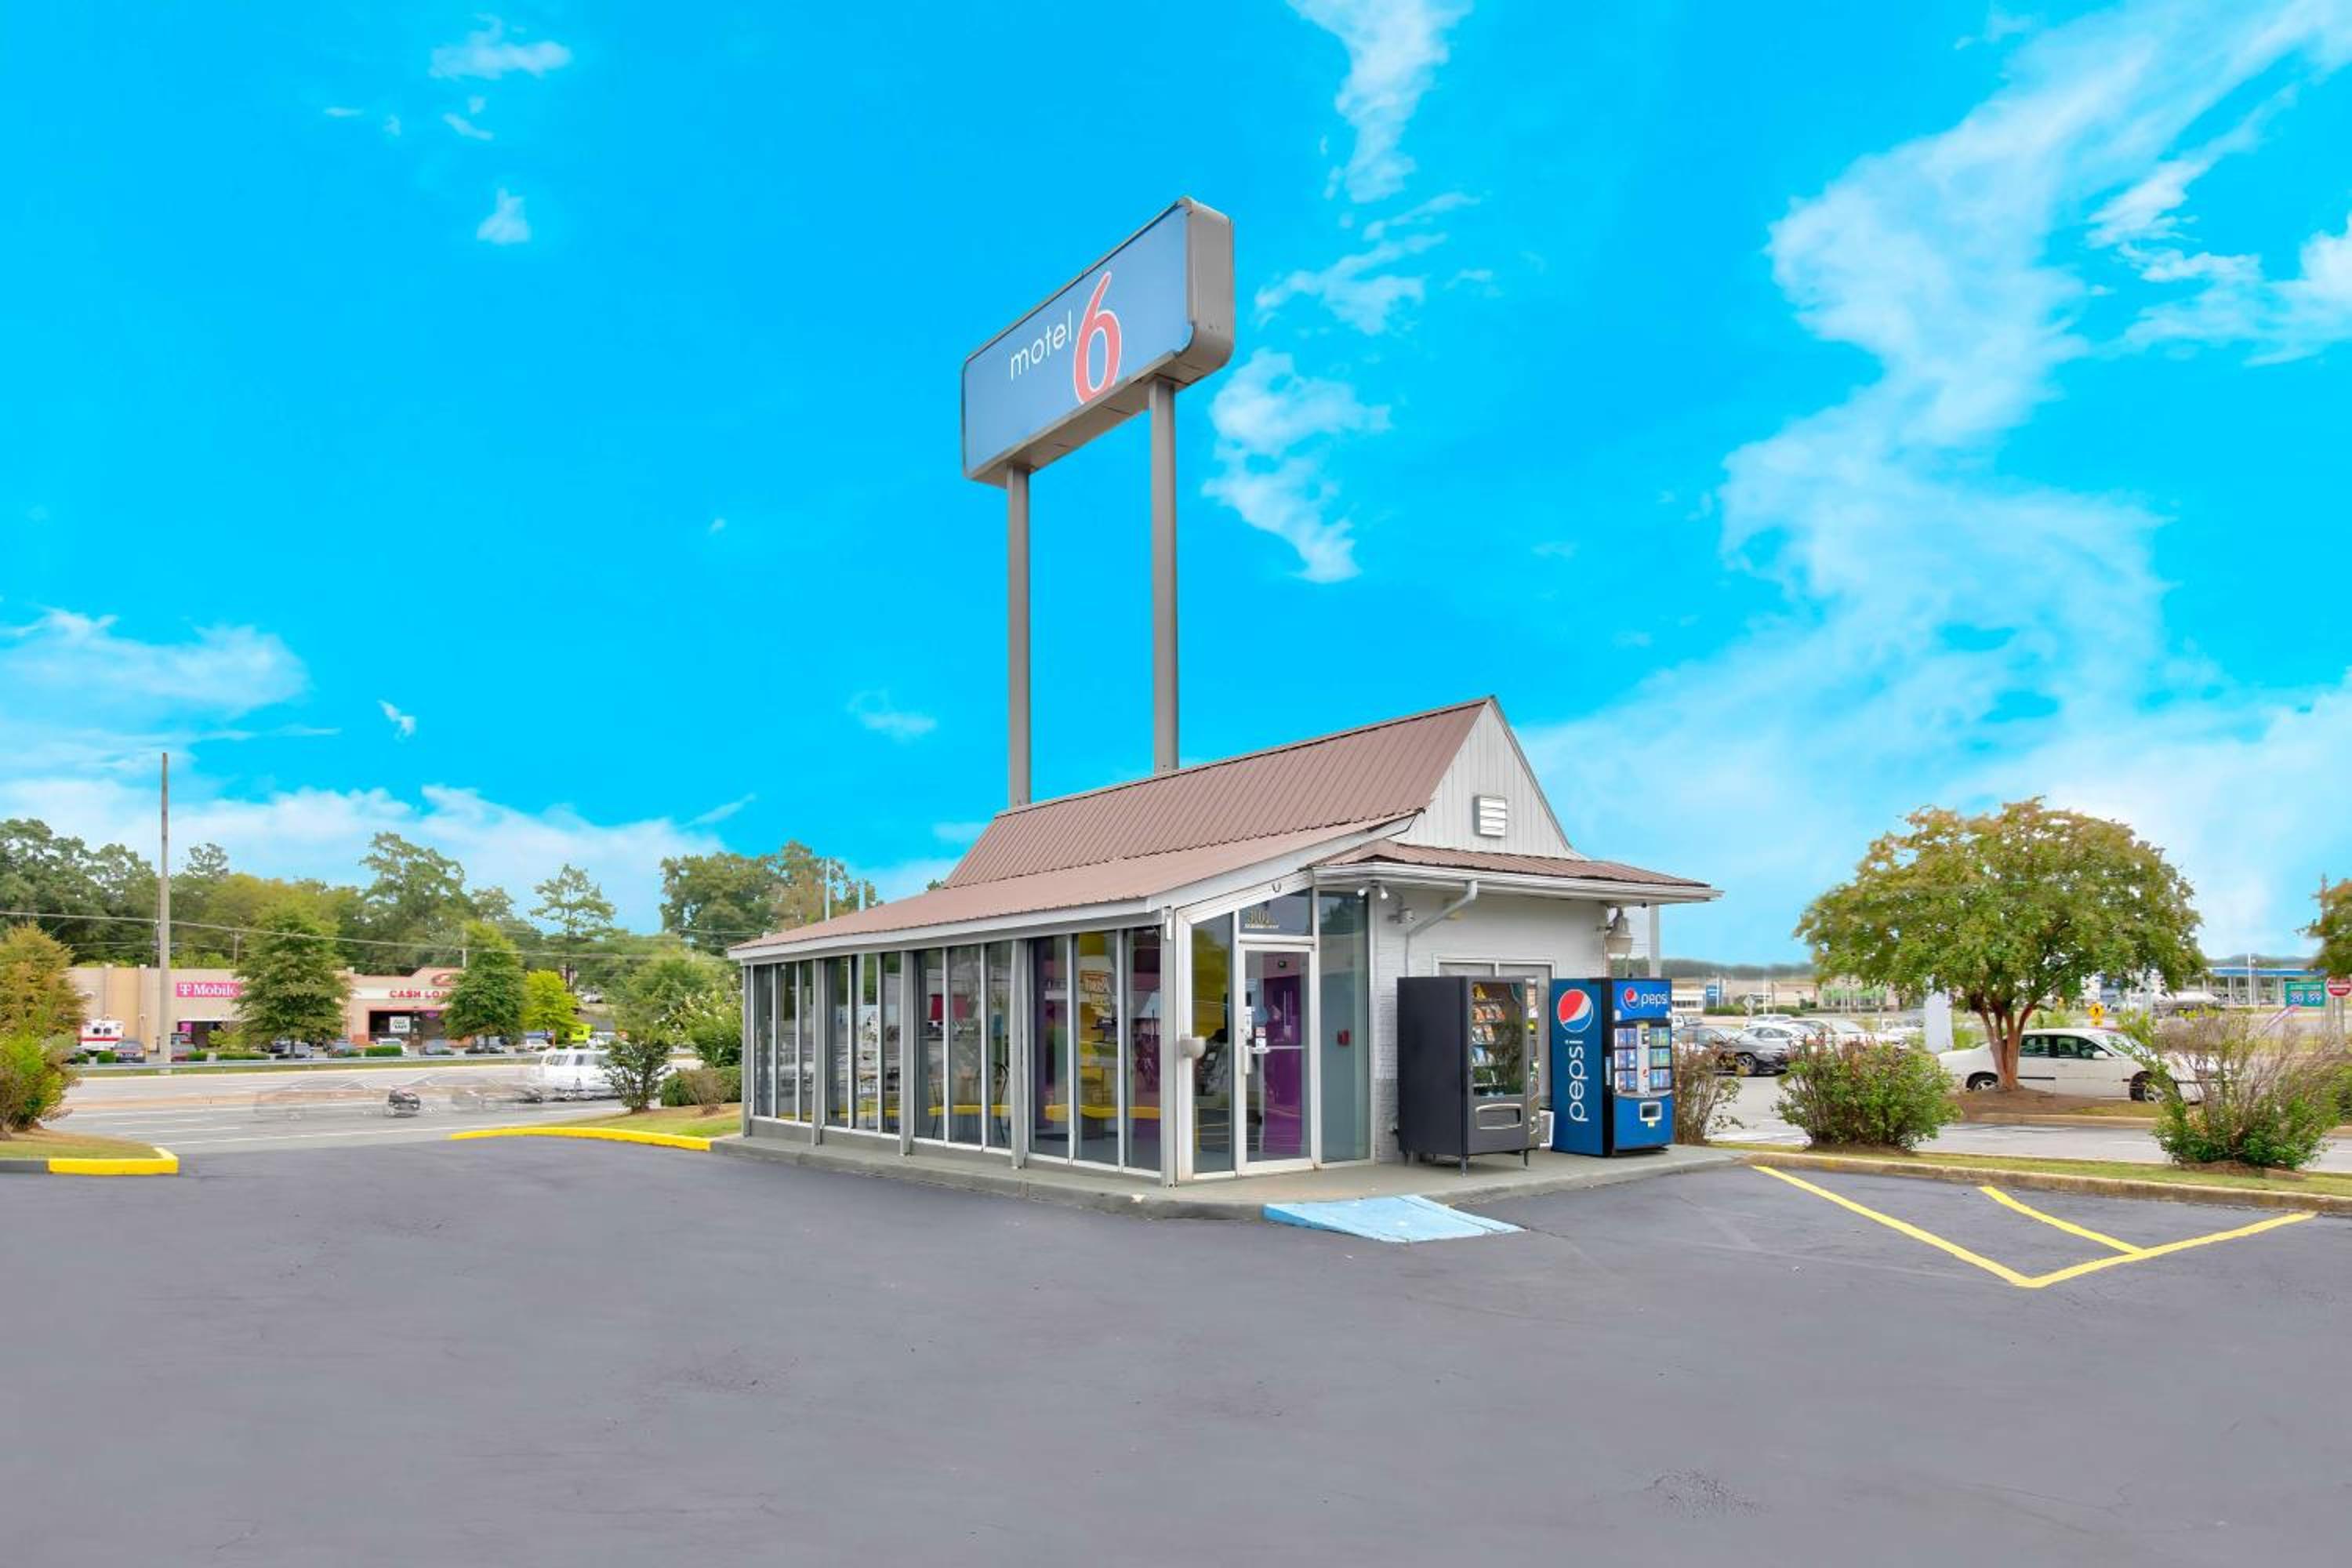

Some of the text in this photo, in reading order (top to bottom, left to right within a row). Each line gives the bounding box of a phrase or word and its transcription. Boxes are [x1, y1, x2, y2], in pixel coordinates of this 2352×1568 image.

[1010, 271, 1122, 405] motel 6
[1565, 1039, 1589, 1122] pepsi
